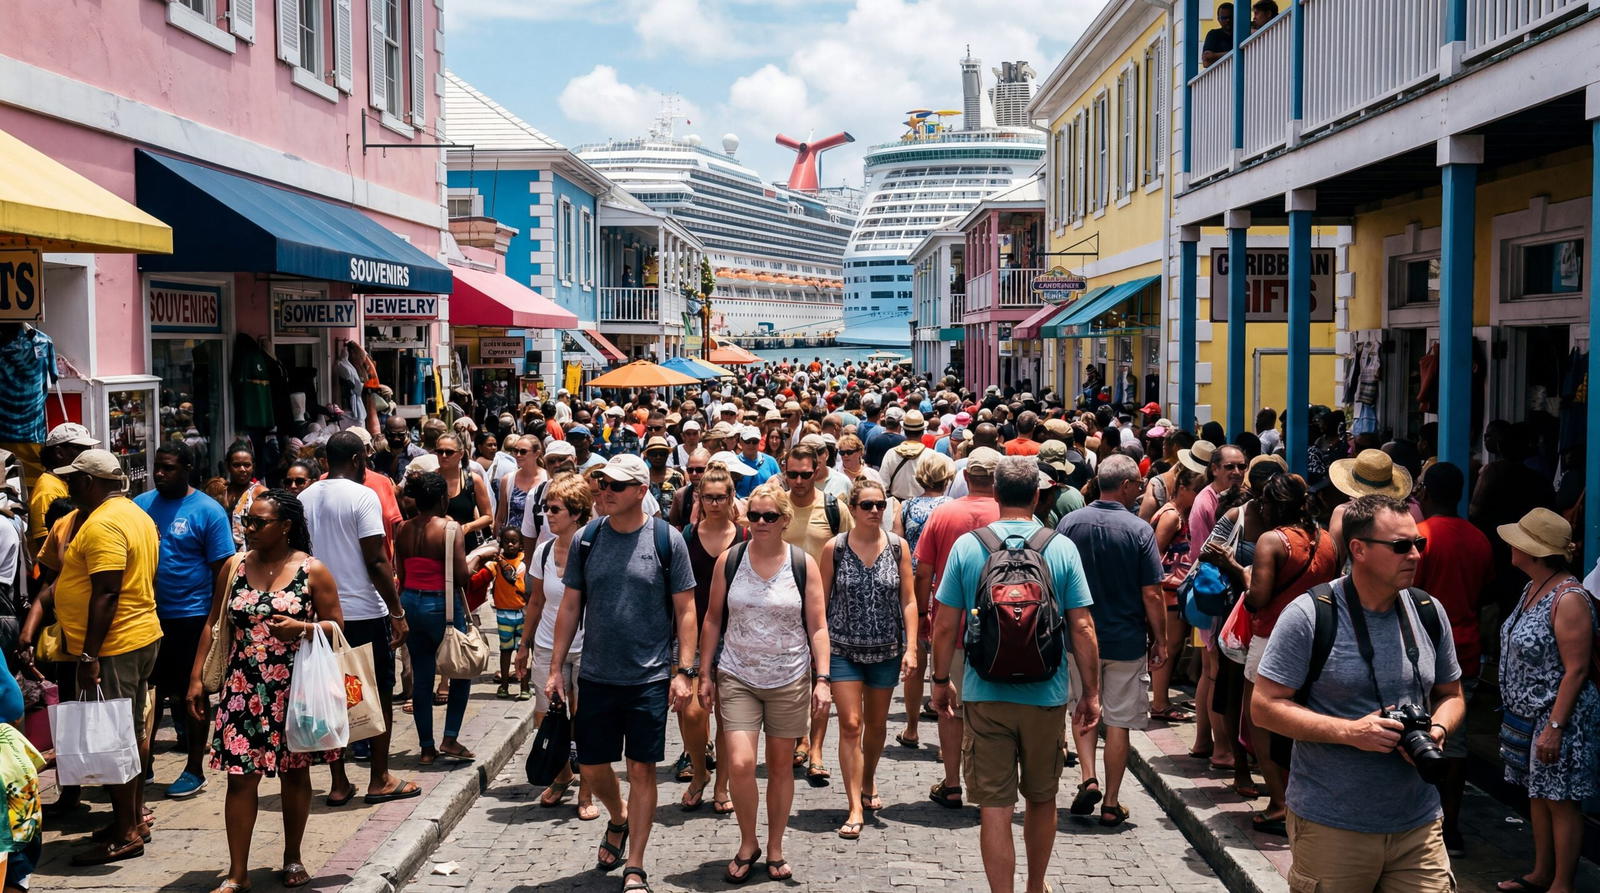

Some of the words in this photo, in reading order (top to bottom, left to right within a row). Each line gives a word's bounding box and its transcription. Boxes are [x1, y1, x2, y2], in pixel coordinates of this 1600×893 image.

[350, 257, 410, 287] SOUVENIRS
[150, 292, 217, 324] SOUVENIRS
[284, 304, 353, 322] SOWELRY
[366, 298, 435, 314] JEWELRY
